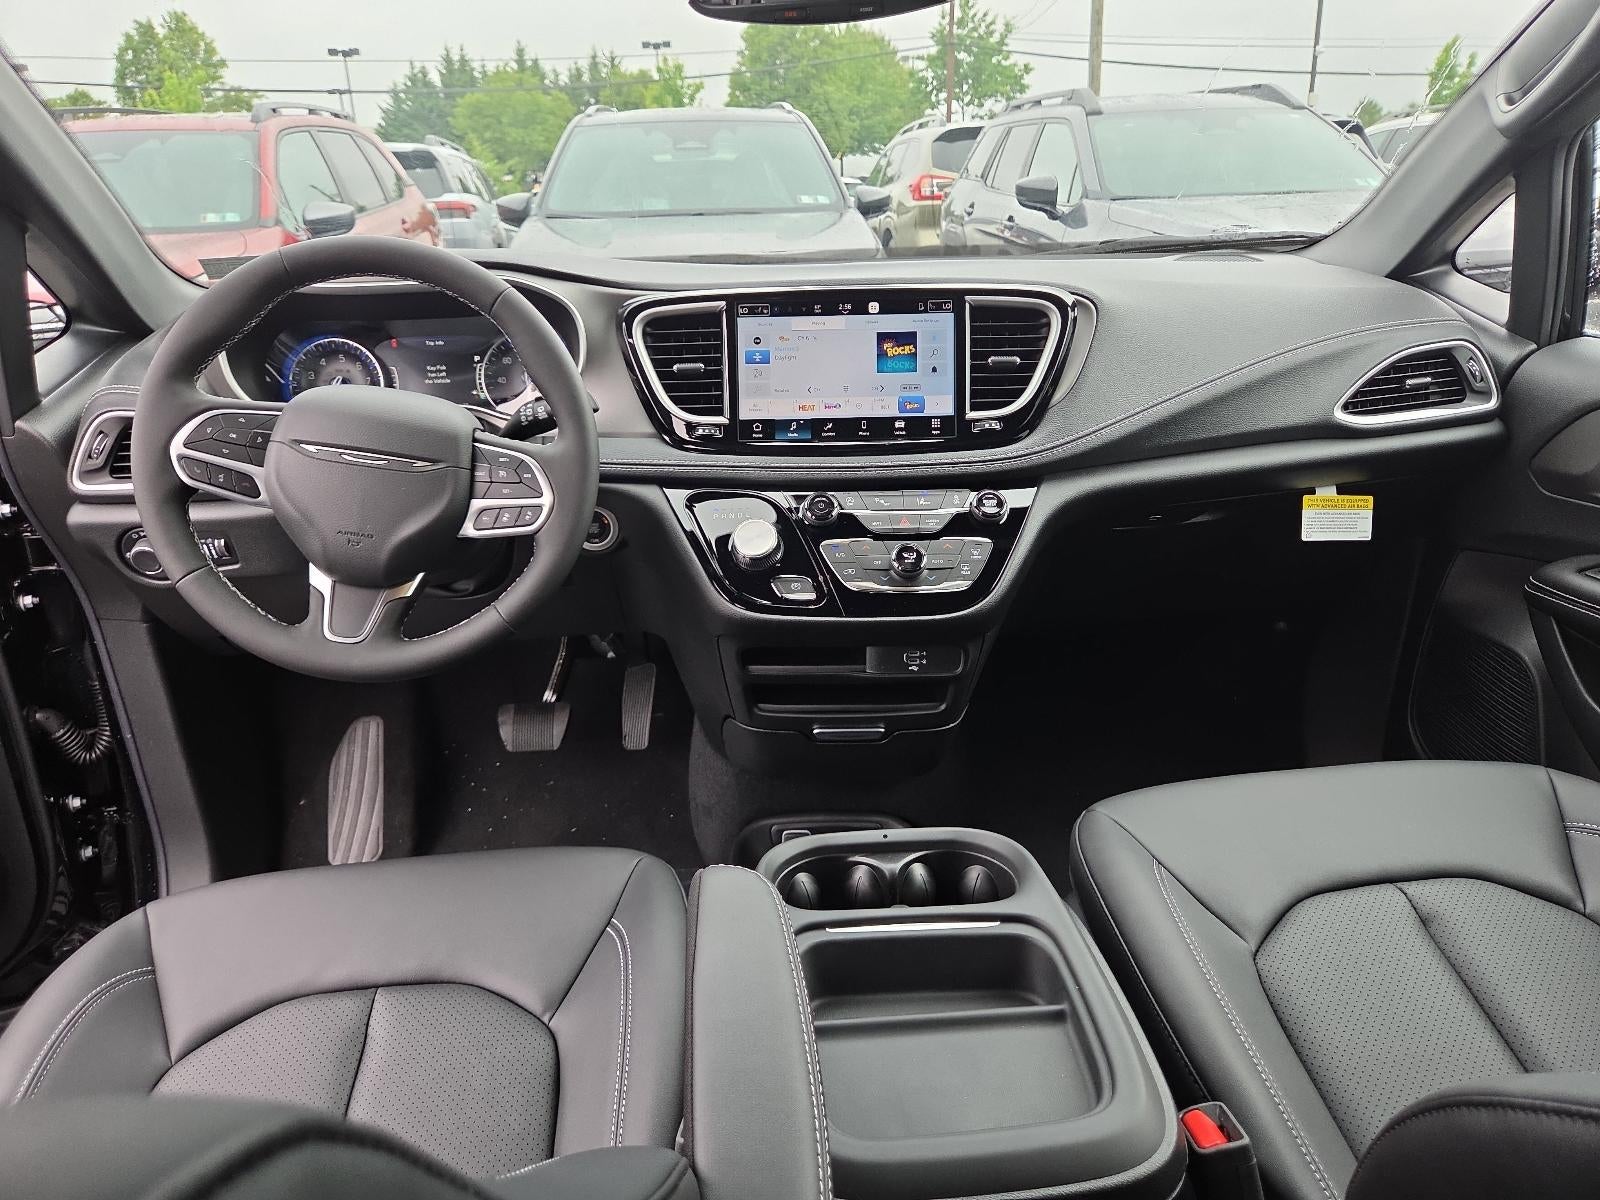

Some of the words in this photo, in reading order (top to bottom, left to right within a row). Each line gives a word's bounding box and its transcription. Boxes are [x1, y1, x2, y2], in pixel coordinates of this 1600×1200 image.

[887, 344, 916, 357] ROCKS
[319, 358, 327, 366] 4
[338, 354, 346, 363] 5
[308, 371, 315, 380] 3
[798, 404, 816, 412] HEAT
[336, 530, 374, 539] AIRBAG
